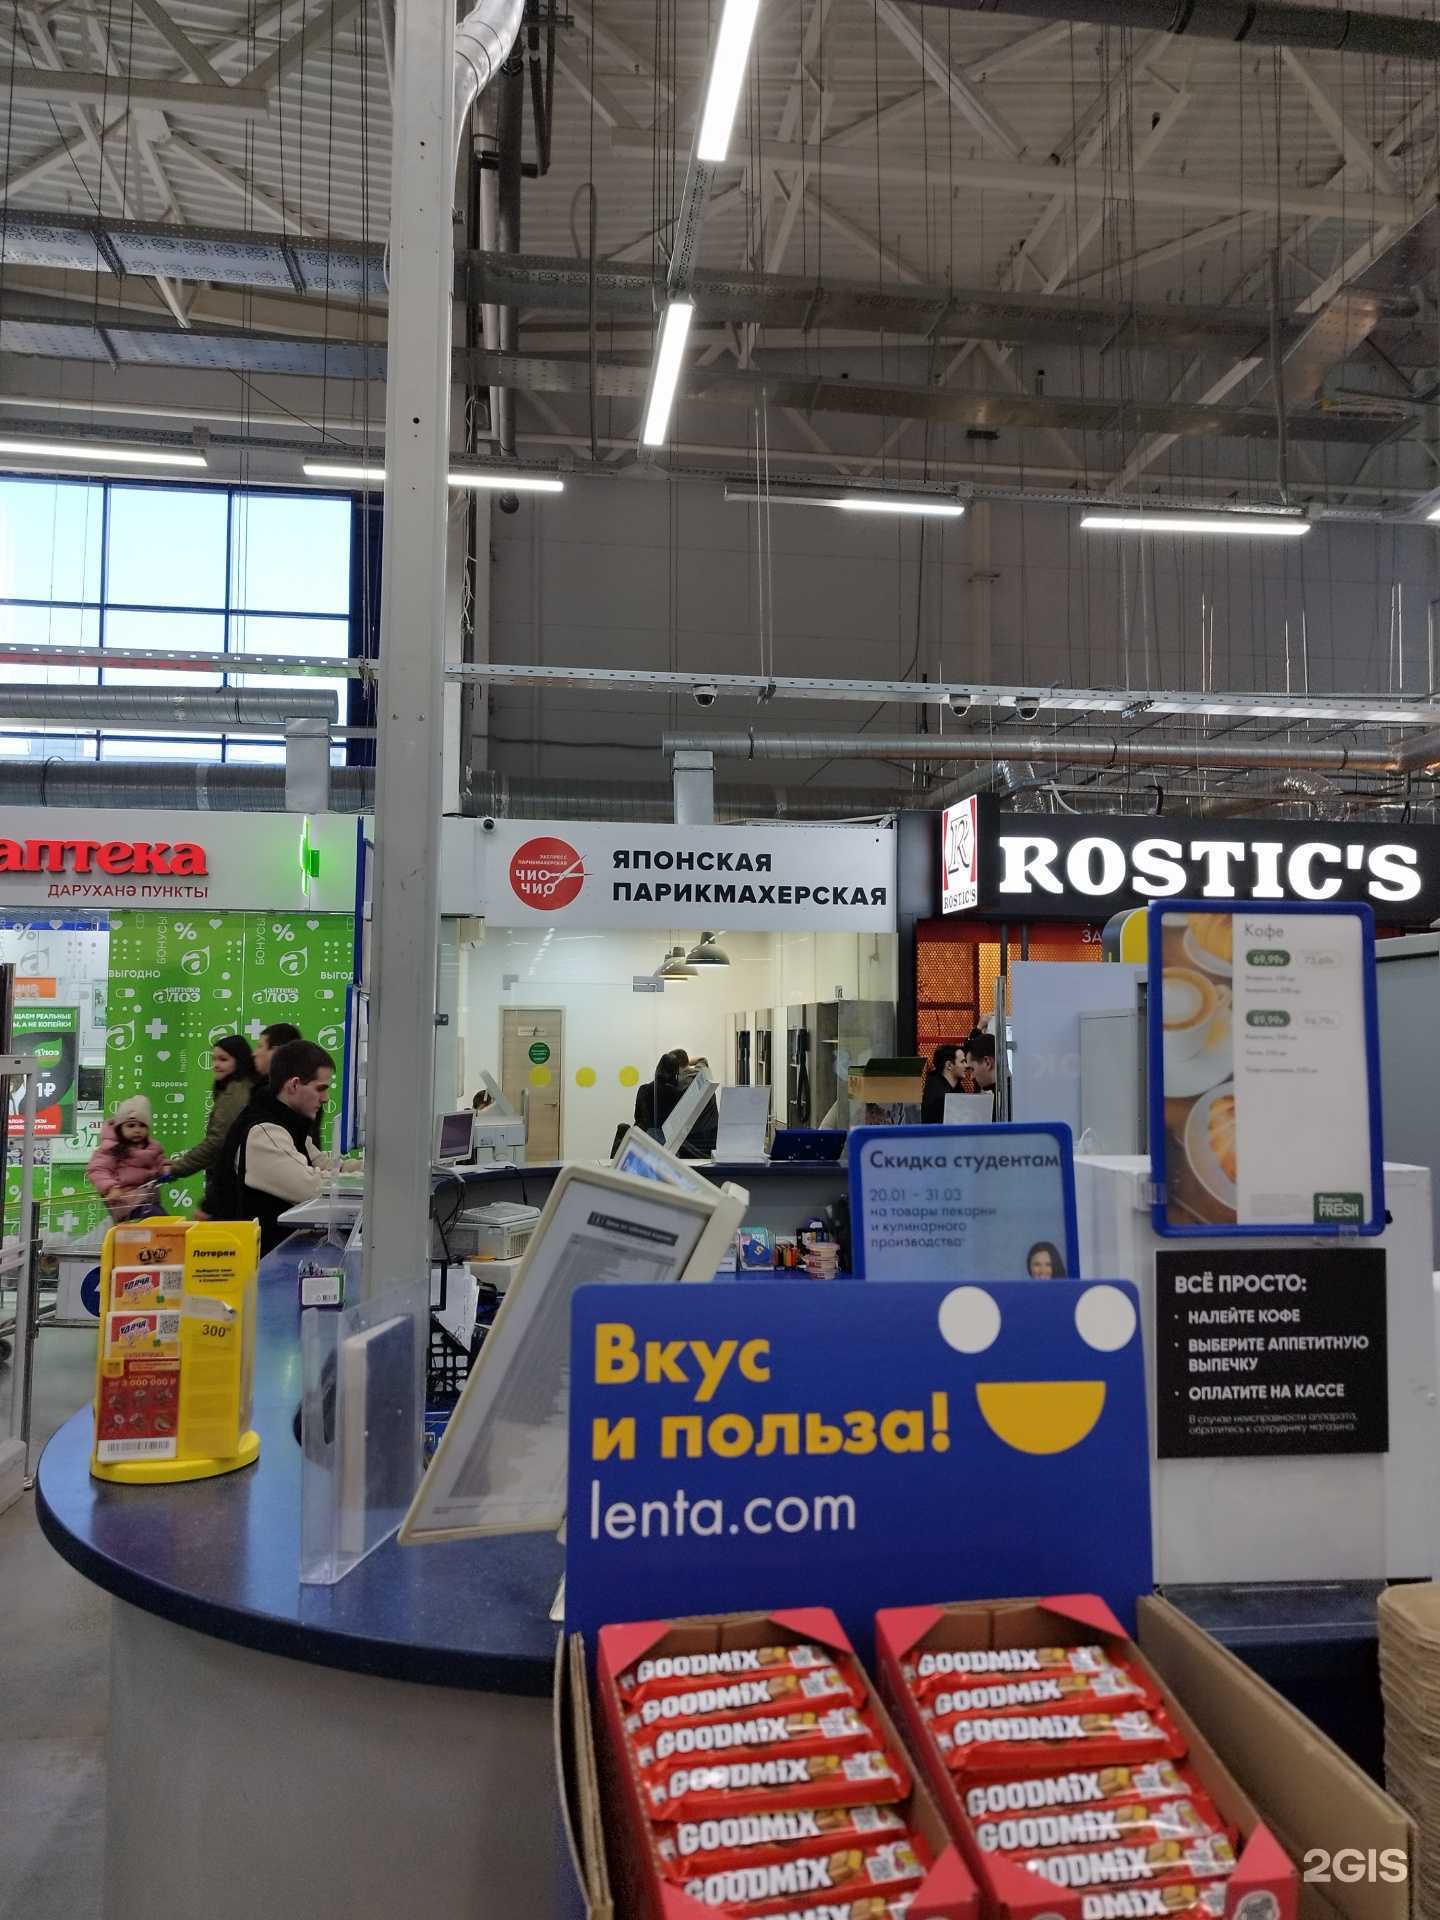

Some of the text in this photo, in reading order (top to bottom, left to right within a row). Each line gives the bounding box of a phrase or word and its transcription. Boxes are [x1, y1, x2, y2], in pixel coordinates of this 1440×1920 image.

[0, 839, 208, 876] аптека
[612, 849, 772, 872] ЯПОНСКАЯ
[515, 869, 550, 881] ЧИО
[998, 836, 1422, 901] ROSTIC'S
[141, 885, 208, 898] ПУНКТЫ
[521, 883, 556, 897] ЧИО
[612, 881, 887, 906] ПАРИКМАХЕРСКАЯ
[943, 888, 977, 910] ROSTIC'S
[156, 916, 168, 966] БОНУСЫ
[255, 918, 266, 966] БОНУСЫ
[1244, 923, 1285, 942] Кофе
[869, 1150, 1059, 1173] Скидка студентам
[870, 1188, 906, 1202] 20.01
[925, 1187, 962, 1201] 31.03
[870, 1205, 997, 1220] на товары пекарни
[1318, 1203, 1360, 1217] FRESH
[871, 1221, 967, 1234] и кулинарного
[1174, 1271, 1307, 1294] ВСЁ ПРОСТО:
[1188, 1307, 1300, 1324] НАЛЕЙТЕ КОФЕ
[202, 1324, 226, 1338] 300
[1188, 1335, 1369, 1353] ВЫБЕРИТЕ АППЕТИТНУЮ
[595, 1322, 770, 1403] Вкус
[1188, 1357, 1259, 1373] ВЫПЕЧКУ
[1188, 1383, 1345, 1401] ОПЛАТИТЕ НА КАССЕ
[592, 1391, 951, 1461] и польза!
[590, 1479, 856, 1540] lenta.com
